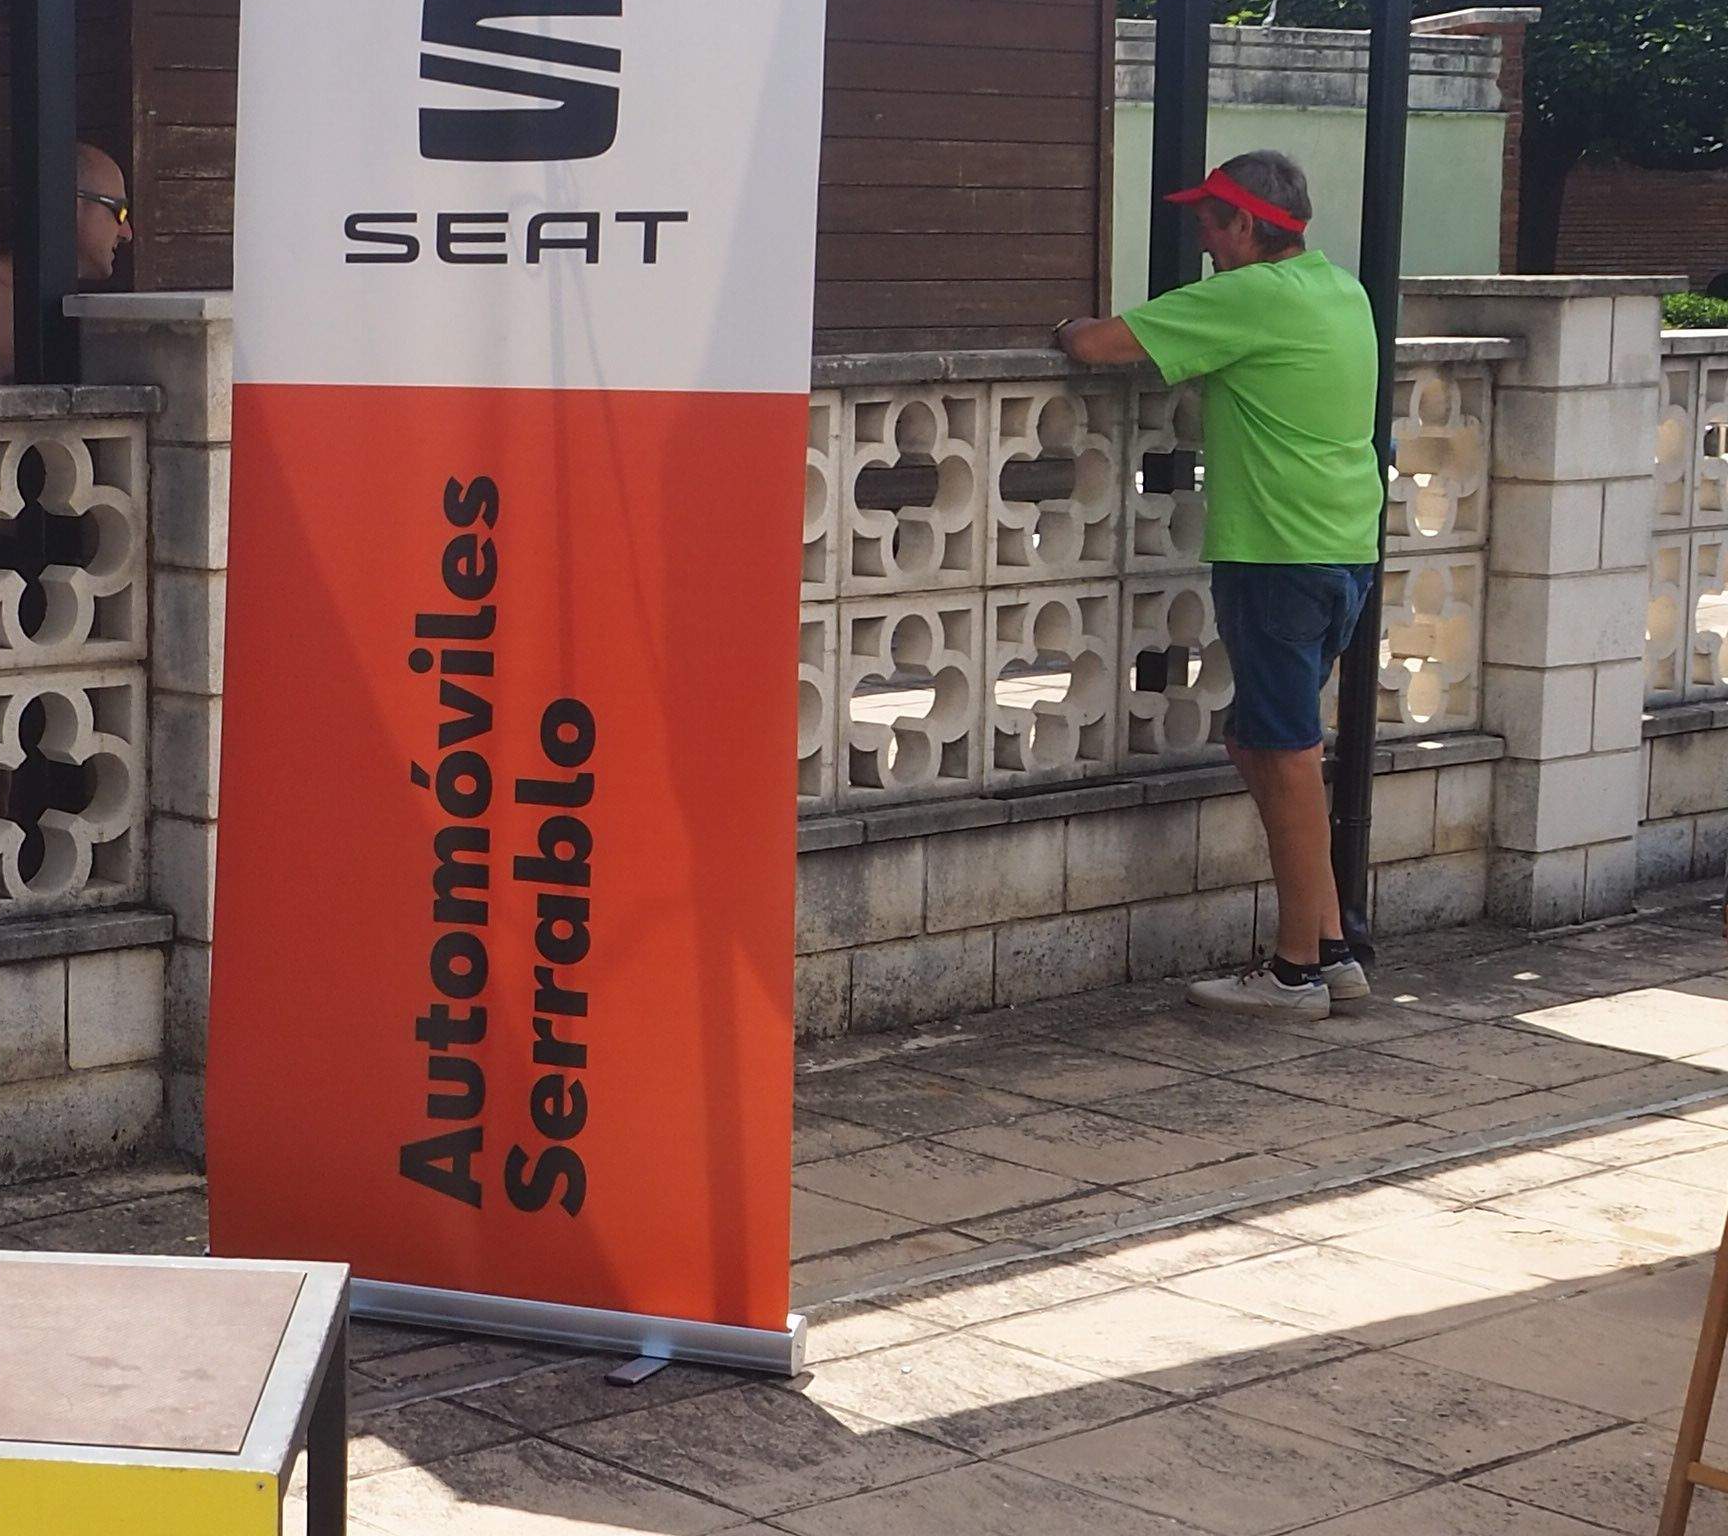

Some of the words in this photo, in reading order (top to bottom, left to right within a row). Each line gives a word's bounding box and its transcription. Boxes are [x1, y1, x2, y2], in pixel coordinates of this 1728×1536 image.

[344, 211, 689, 264] SEAT
[399, 475, 500, 1210] Automóviles
[504, 697, 597, 1219] Serrablo
